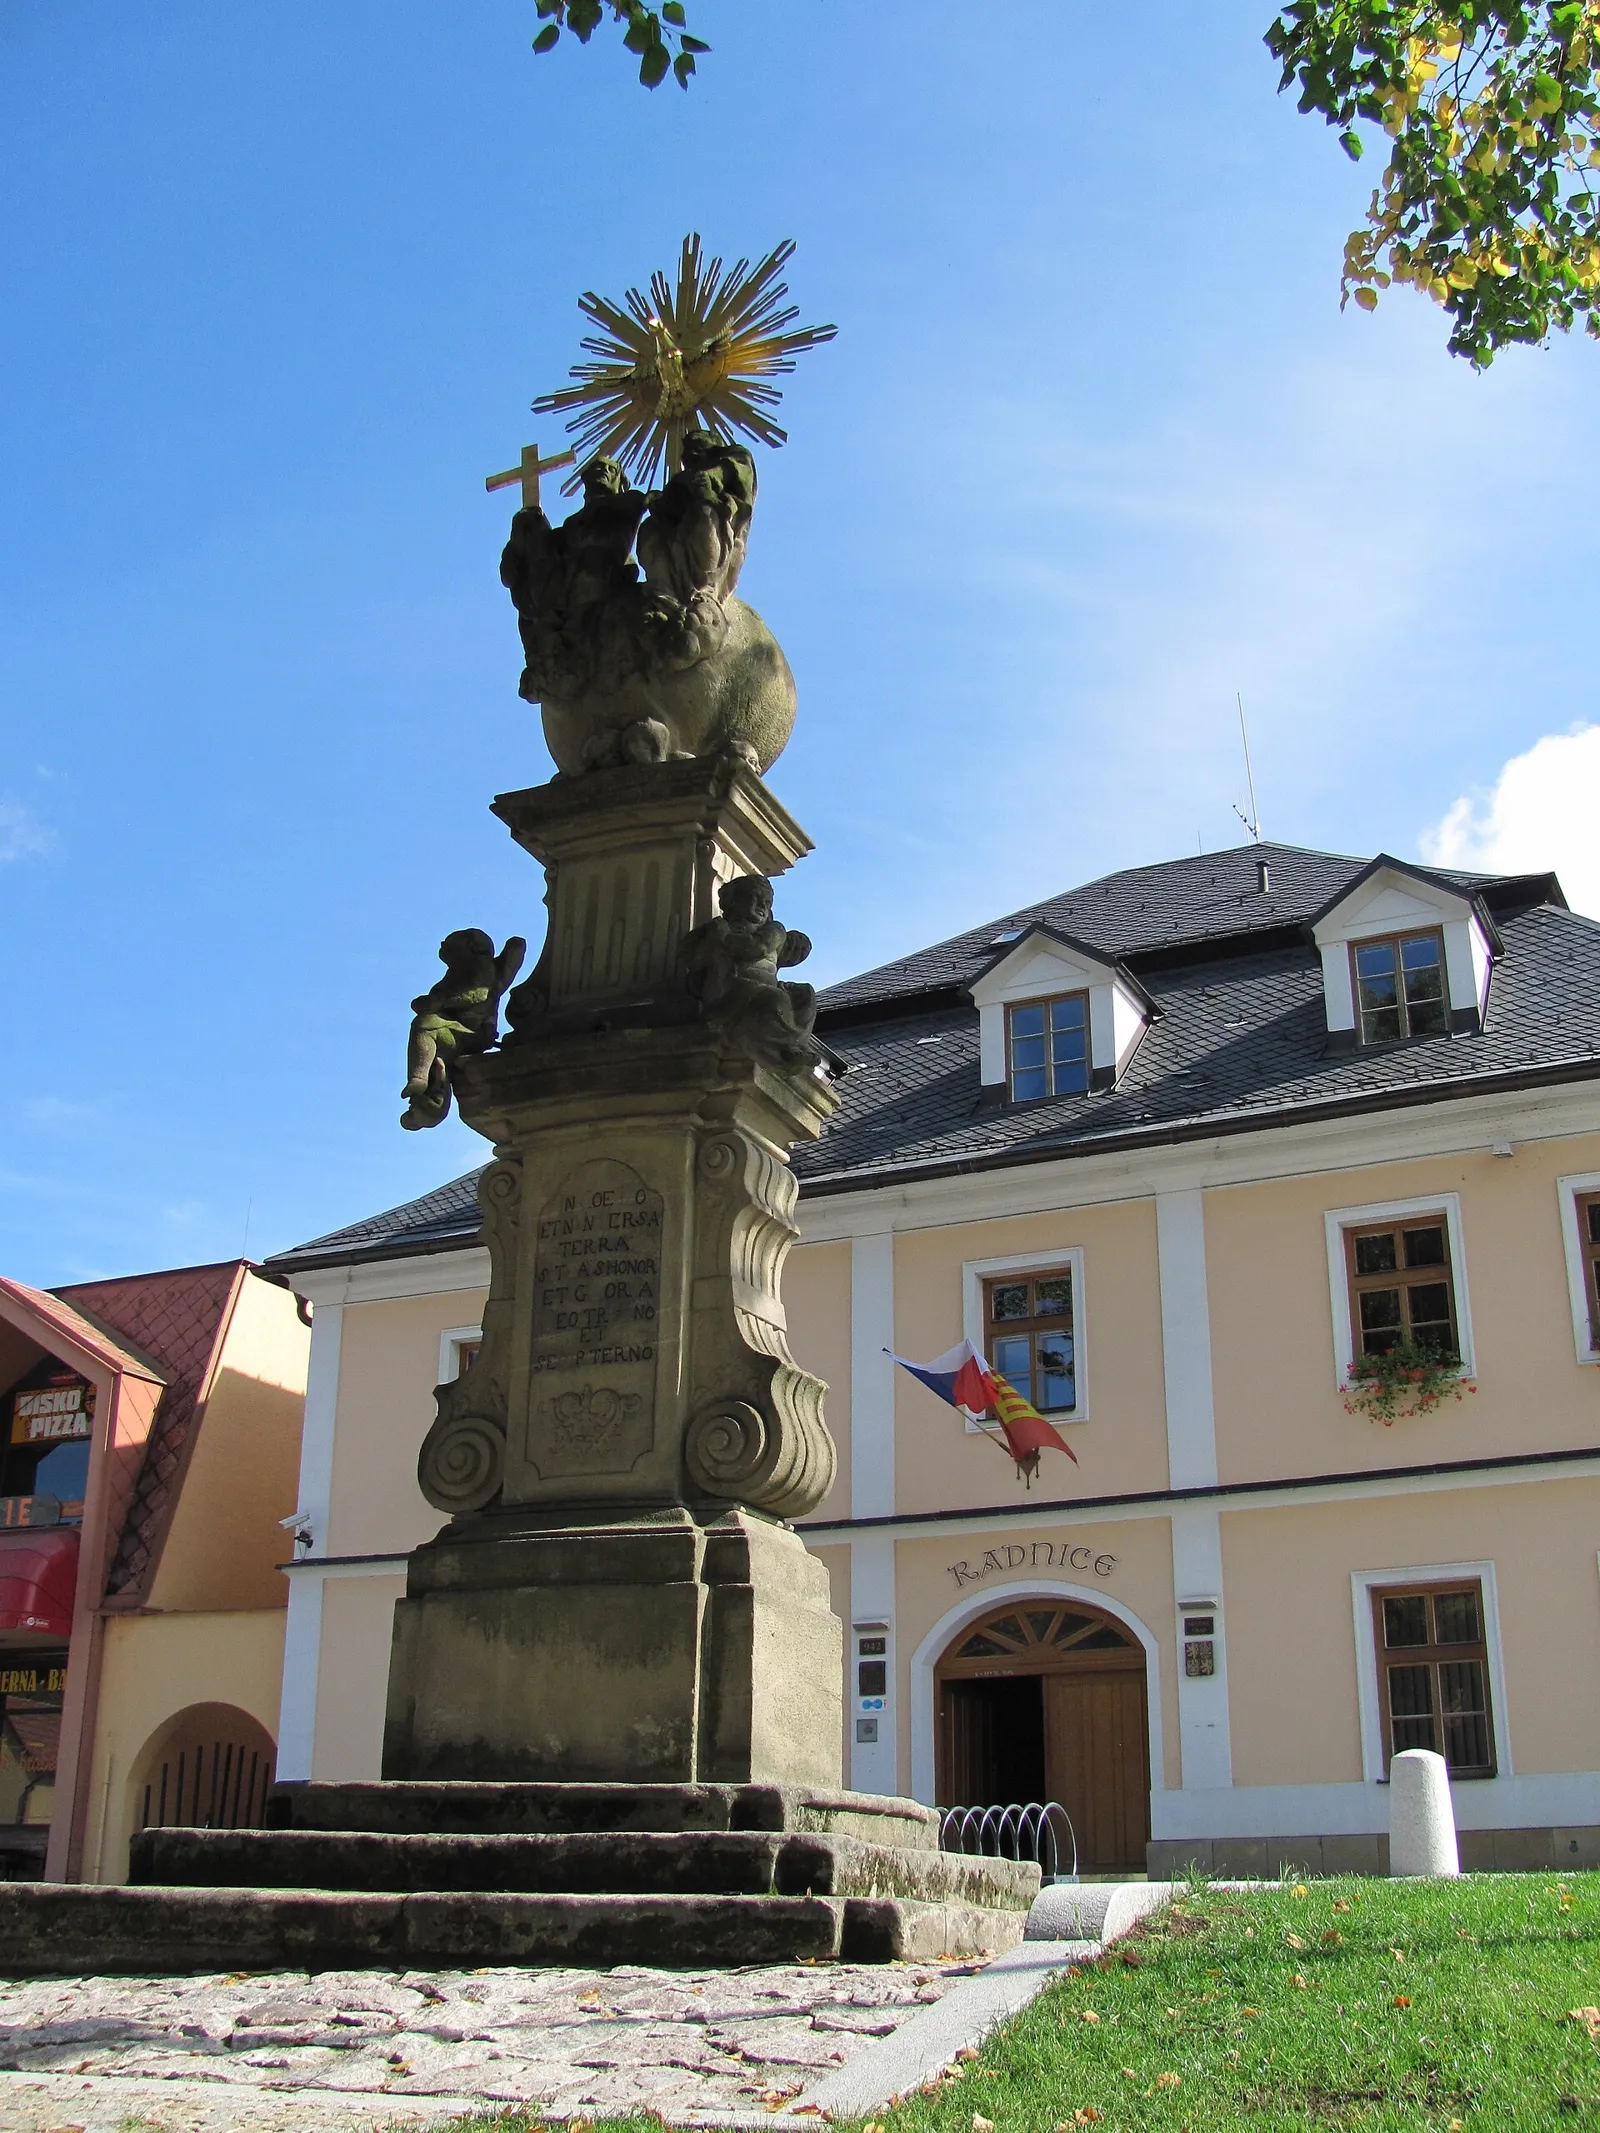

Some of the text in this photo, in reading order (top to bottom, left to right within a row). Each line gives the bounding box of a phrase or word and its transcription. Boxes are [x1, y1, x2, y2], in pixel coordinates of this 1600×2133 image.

[559, 1236, 631, 1258] TERRA
[579, 1325, 609, 1344] ET
[19, 1390, 81, 1416] DISKO
[30, 1412, 87, 1438] PIZZA
[947, 1541, 1120, 1588] RADNICE
[0, 1669, 37, 1692] ERNA
